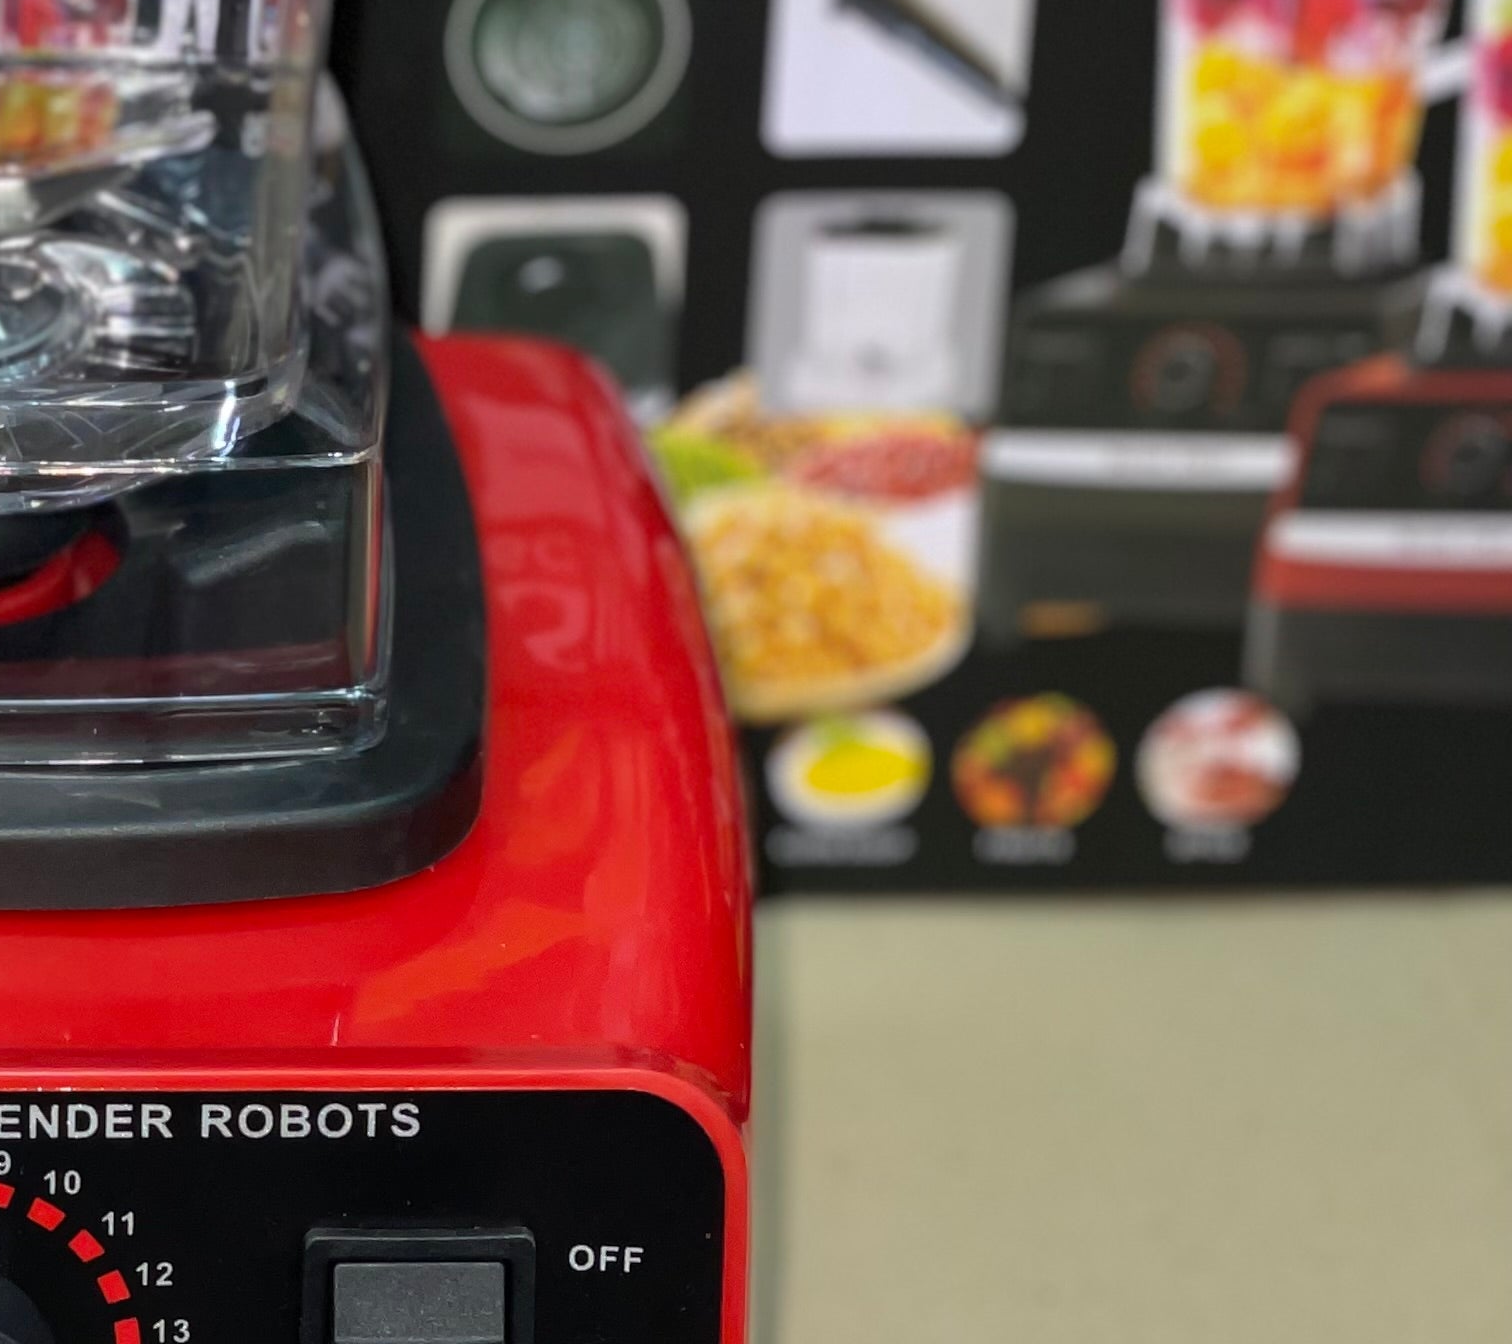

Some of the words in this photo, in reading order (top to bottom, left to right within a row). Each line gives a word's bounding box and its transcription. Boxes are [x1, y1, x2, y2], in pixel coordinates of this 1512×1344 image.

[199, 1101, 421, 1140] ROBOTS
[43, 1169, 81, 1195] 10
[101, 1211, 134, 1236] 11
[567, 1243, 645, 1274] OFF
[135, 1261, 173, 1287] 12
[152, 1318, 191, 1344] 13
